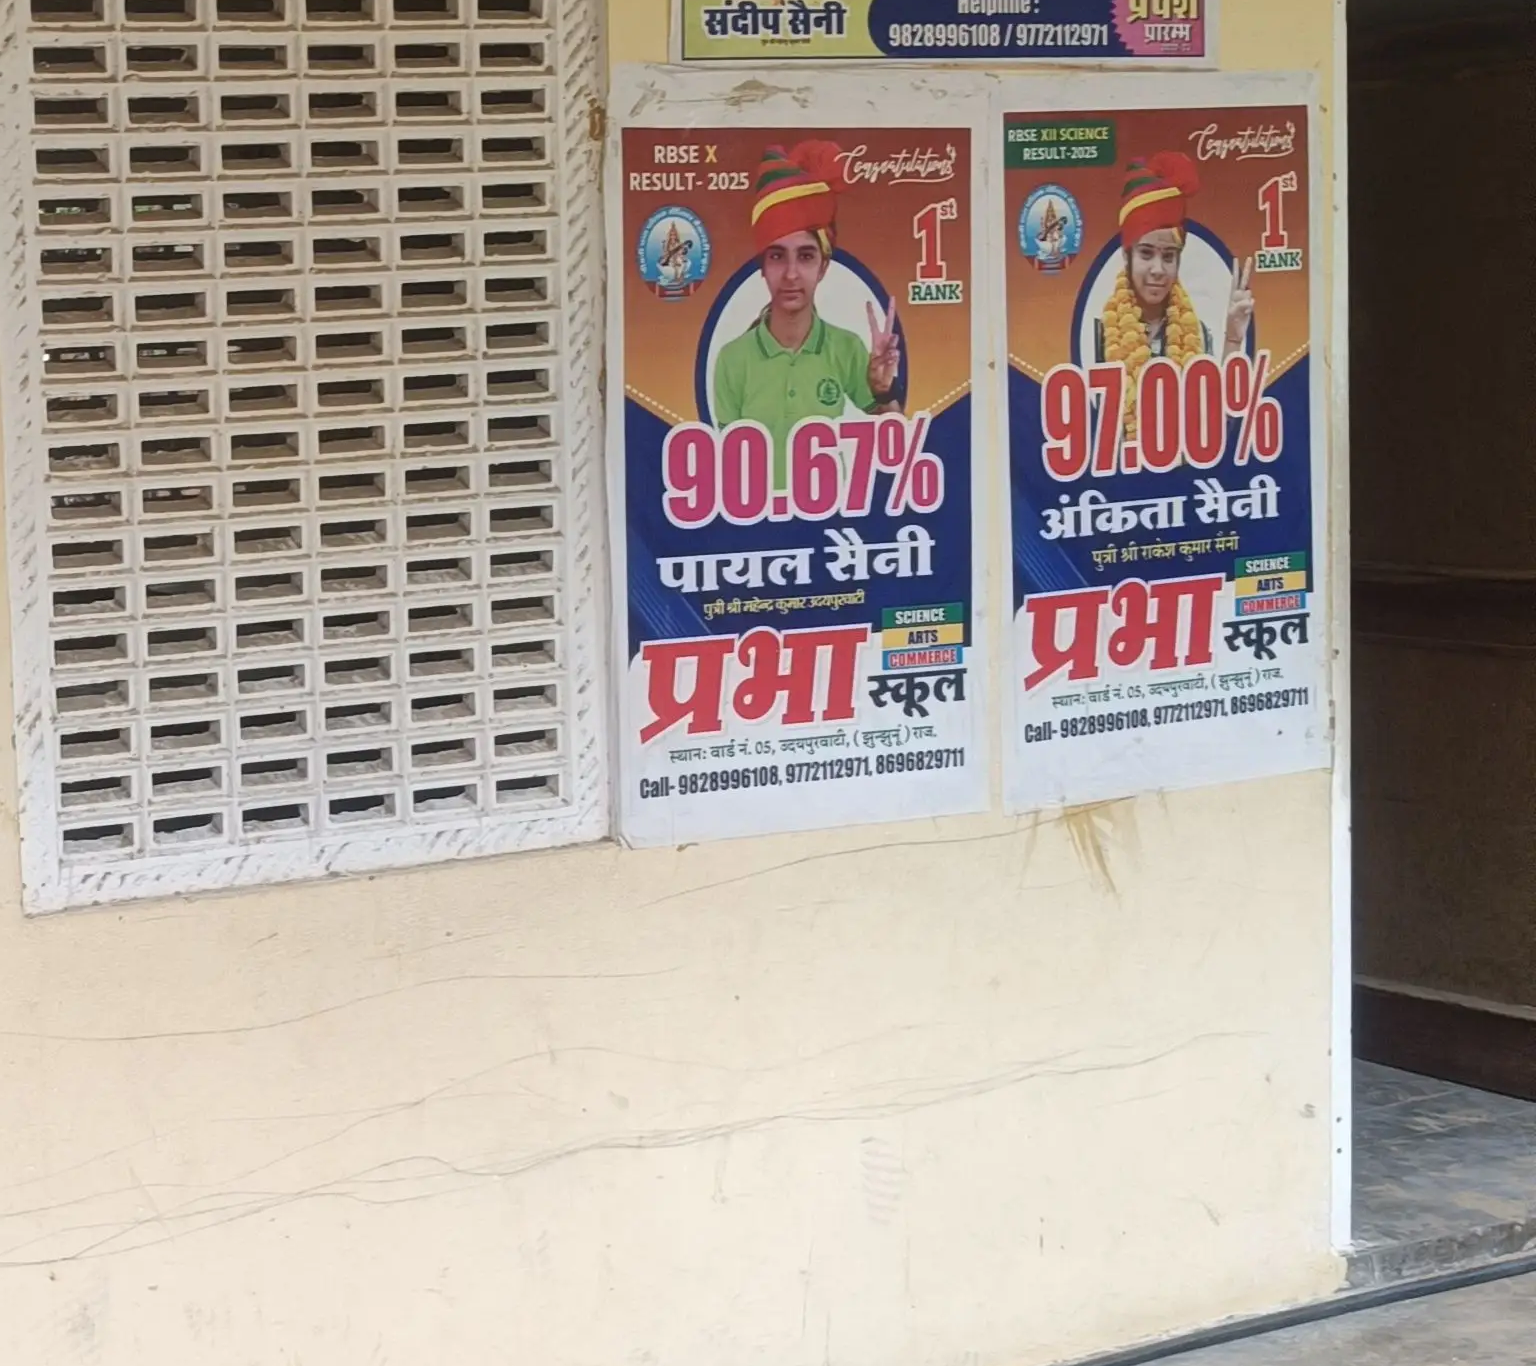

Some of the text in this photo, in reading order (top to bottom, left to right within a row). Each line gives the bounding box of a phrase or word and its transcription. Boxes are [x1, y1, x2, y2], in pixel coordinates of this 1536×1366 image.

[704, 0, 847, 36] संदीप सैनी
[889, 24, 1108, 47] 9828996108 9772112971
[1144, 24, 1192, 42] प्रारम्भ
[1007, 126, 1109, 143] RBSE XII SCIENCE
[654, 145, 718, 164] RBSE X
[630, 172, 750, 191] RESULT- 2025
[1257, 251, 1300, 269] RANK
[911, 283, 961, 302] RANK
[1044, 354, 1280, 478] 97.00%
[667, 417, 939, 523] 90.67%
[1039, 473, 1281, 541] अंकिता सैनी
[1141, 531, 1240, 563] राकेश कुमार सैनी
[656, 525, 936, 593] पायल सैनी
[1245, 556, 1290, 573] SCIENCE
[1256, 577, 1284, 592] ARTS
[1240, 595, 1302, 614] COMMERCE
[895, 607, 945, 625] SCIENCE
[908, 629, 938, 644] ARTS
[1024, 576, 1310, 692] प्रभा स्कूल
[889, 650, 957, 668] COMMERCE
[640, 627, 967, 745] प्रभा स्कूल
[1230, 687, 1309, 715] 8696829711
[678, 766, 783, 796] 9828996108,
[786, 757, 873, 785] 9772112971,
[876, 747, 965, 775] 8696829711
